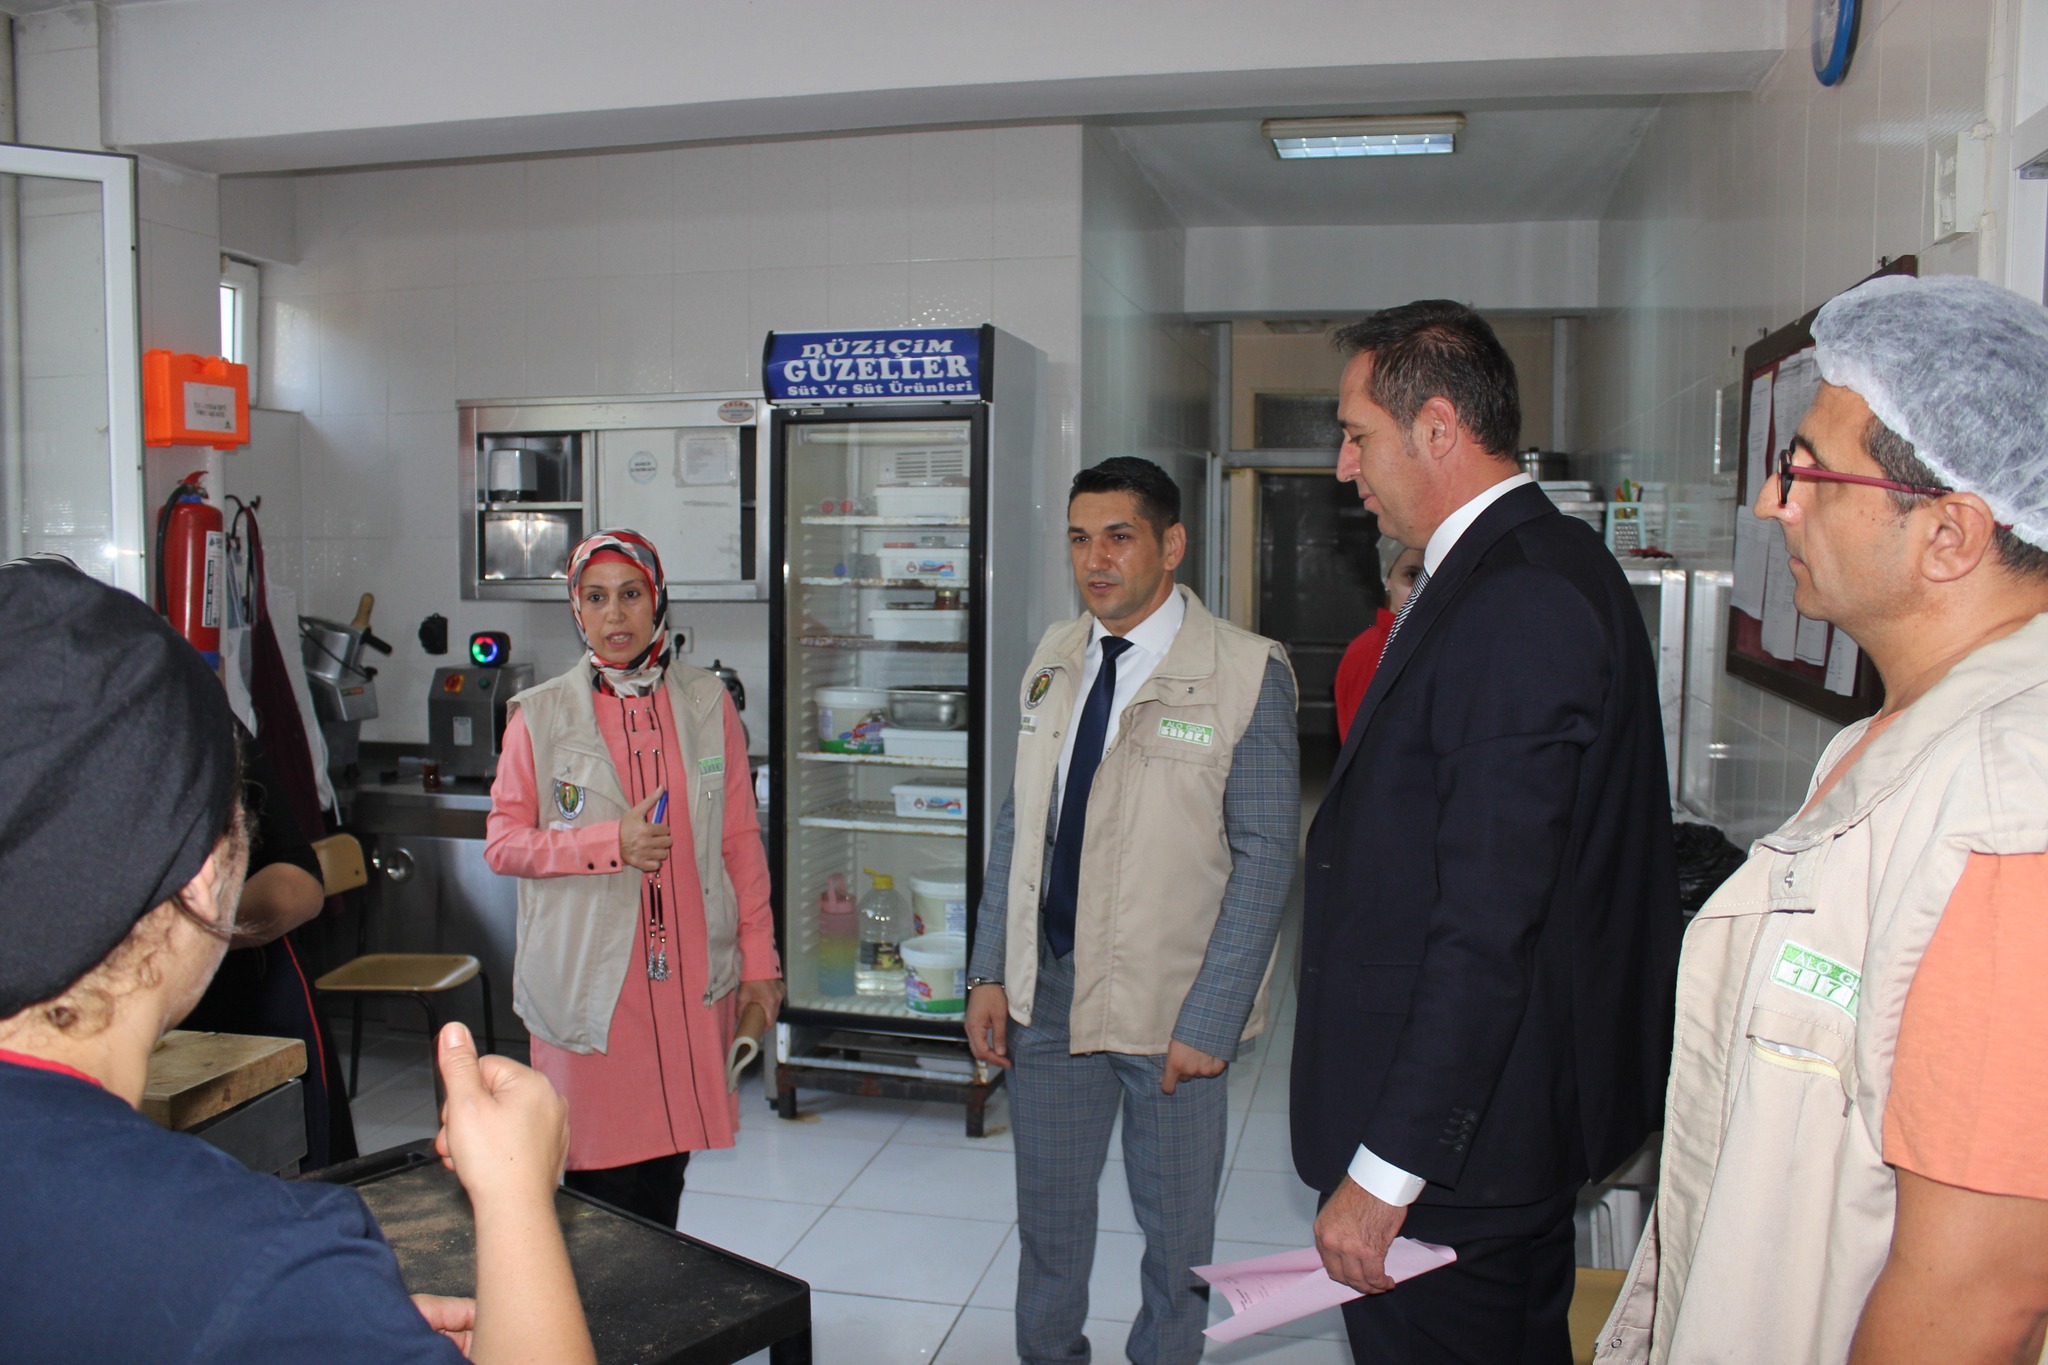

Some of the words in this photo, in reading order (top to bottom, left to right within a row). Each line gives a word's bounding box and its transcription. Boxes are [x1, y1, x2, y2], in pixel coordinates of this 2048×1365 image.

[783, 354, 972, 382] GÜZELLER
[787, 385, 819, 396] Süt
[823, 384, 848, 395] Ve
[852, 383, 884, 395] Süt
[889, 380, 974, 394] Ürünleri
[1793, 951, 1832, 975] ALO
[1839, 971, 1860, 991] GI
